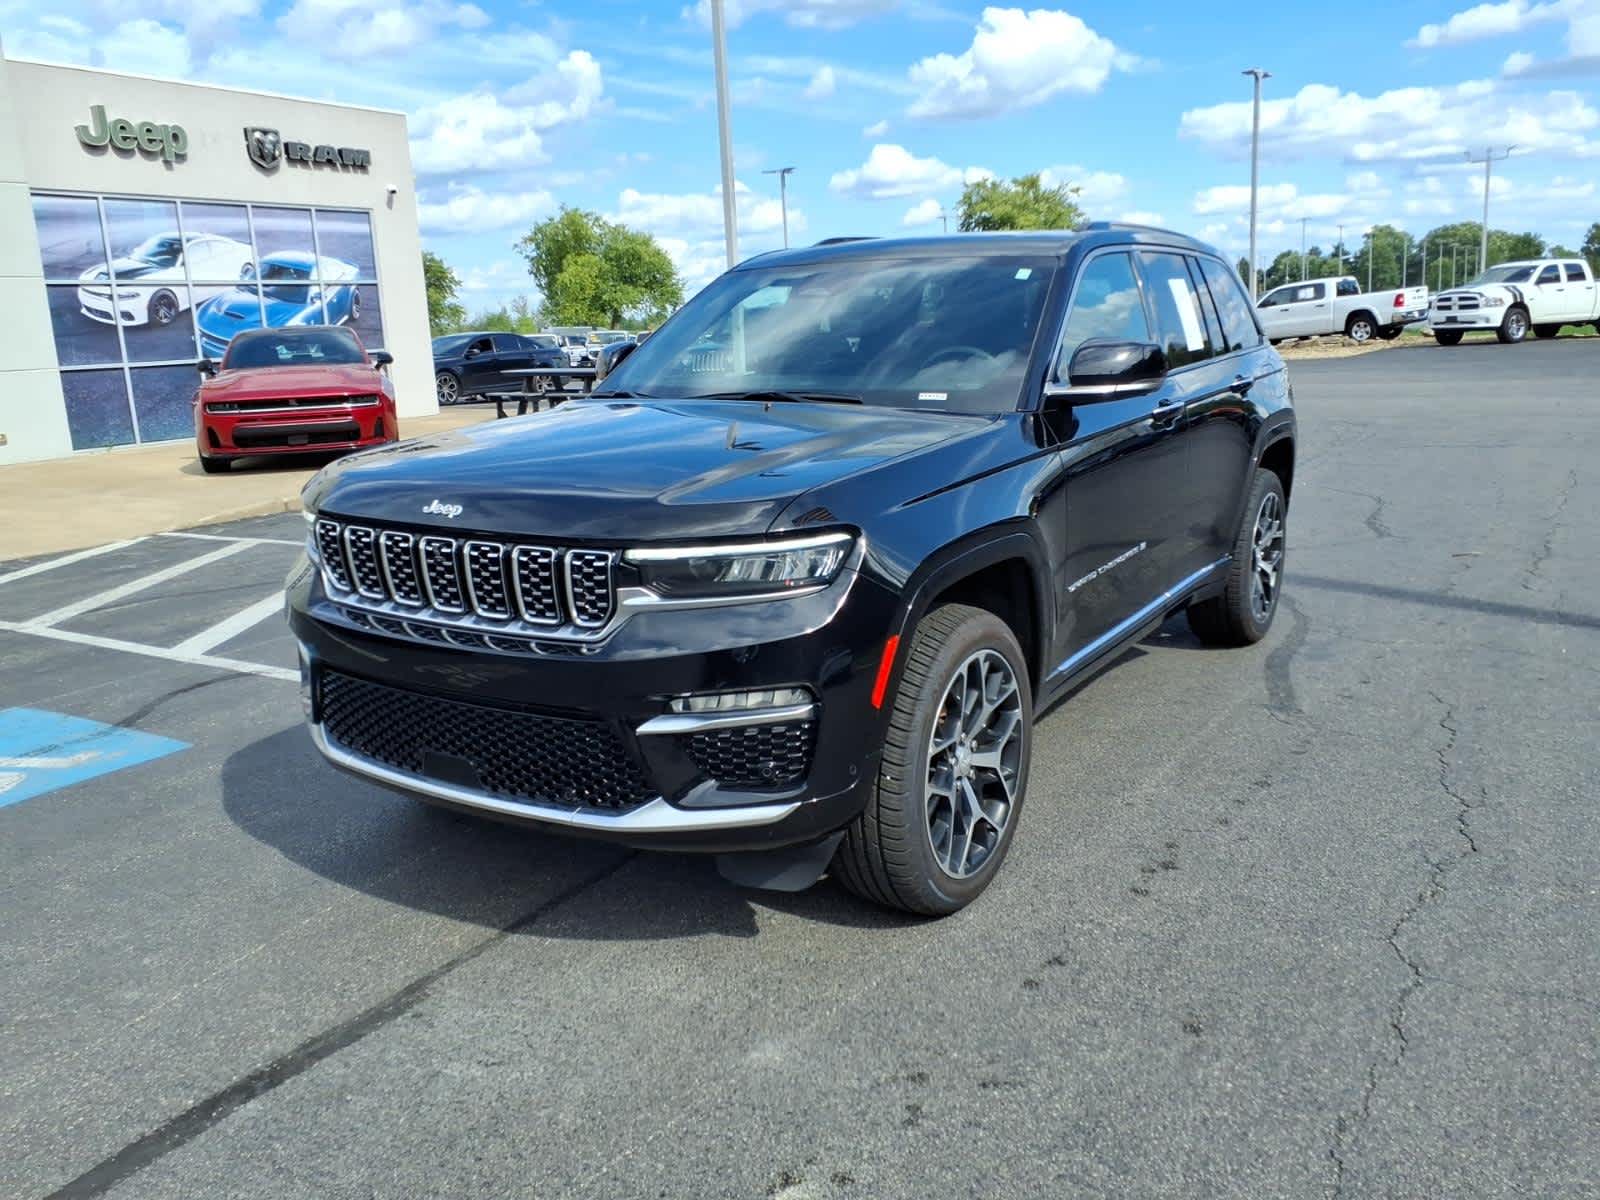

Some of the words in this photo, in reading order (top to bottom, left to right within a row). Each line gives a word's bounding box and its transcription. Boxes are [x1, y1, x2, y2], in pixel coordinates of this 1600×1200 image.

[74, 105, 189, 161] Jeep
[284, 141, 371, 168] RAM
[422, 499, 463, 519] Jeep
